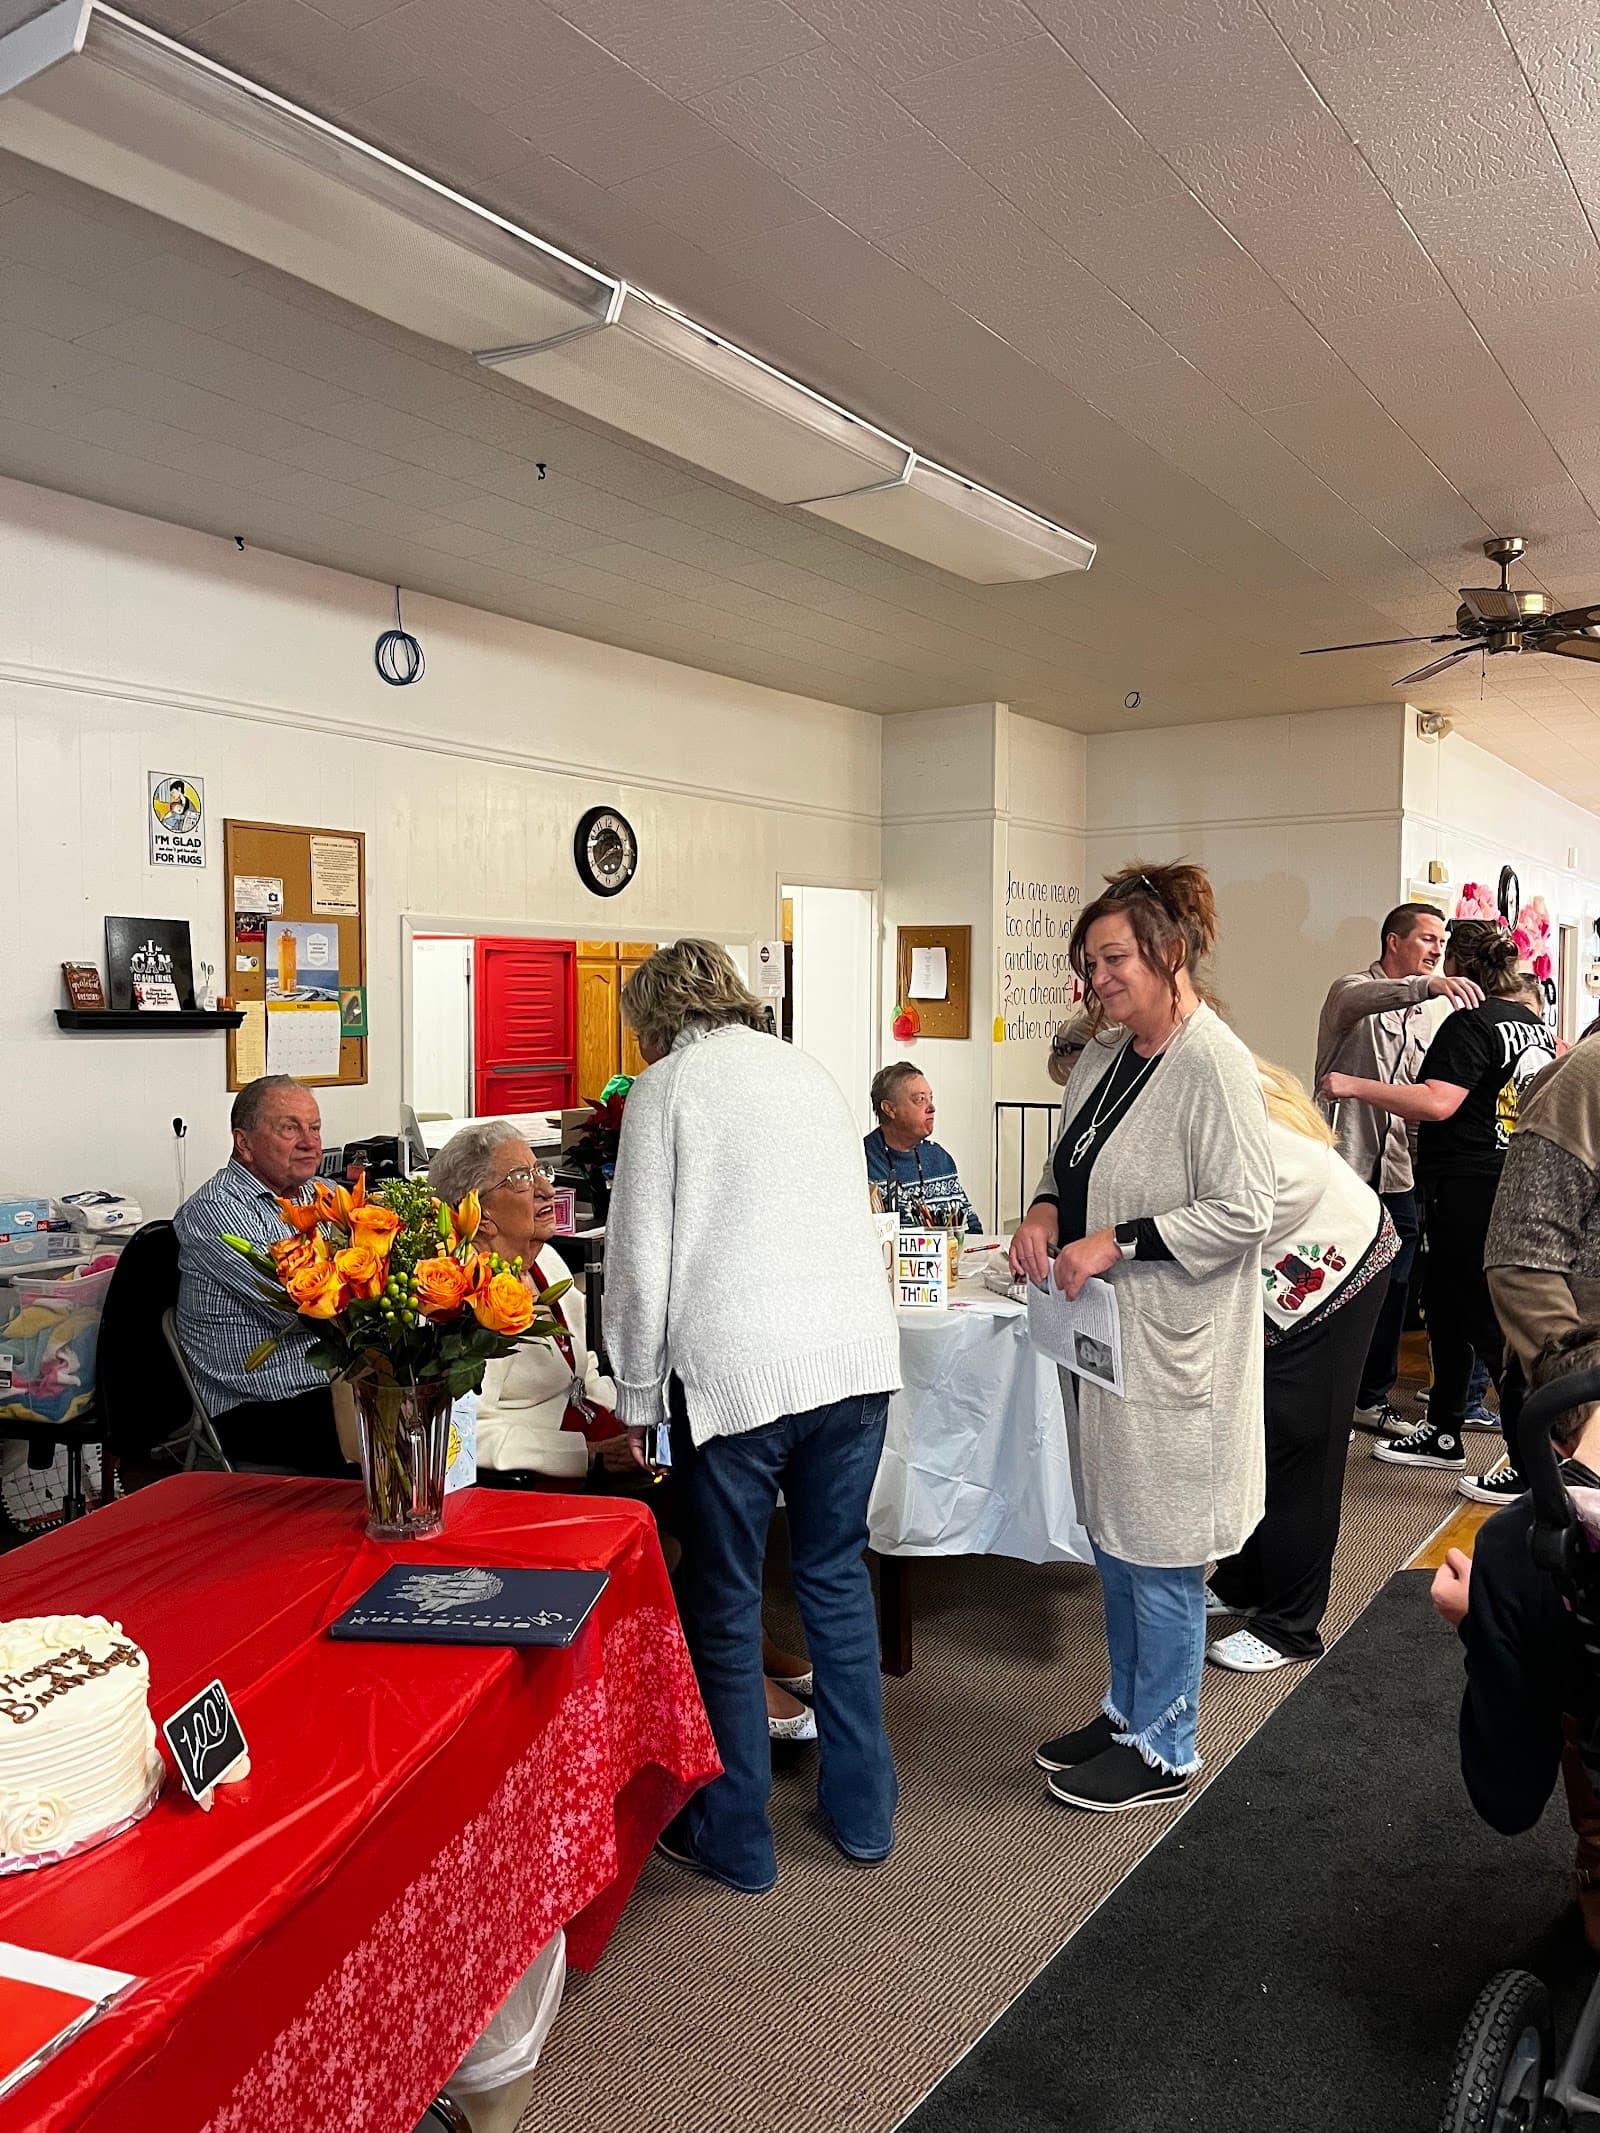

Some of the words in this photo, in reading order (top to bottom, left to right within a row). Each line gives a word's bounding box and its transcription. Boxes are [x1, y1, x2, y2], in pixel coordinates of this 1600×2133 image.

[155, 835, 169, 845] I'M
[173, 836, 201, 847] GLAD
[156, 853, 174, 863] FOR
[177, 854, 202, 865] HUGS
[1028, 882, 1048, 901] are
[1050, 885, 1080, 904] never
[1006, 910, 1023, 937] too
[1026, 908, 1042, 938] old
[1045, 913, 1056, 938] to
[1058, 914, 1075, 939] set
[131, 952, 173, 974] CAN
[1005, 942, 1049, 971] another
[1052, 953, 1072, 978] goa
[1013, 987, 1027, 1006] or
[1004, 1010, 1042, 1041] nother
[899, 1237, 941, 1253] HAPPY
[0, 1643, 93, 1694] Happy
